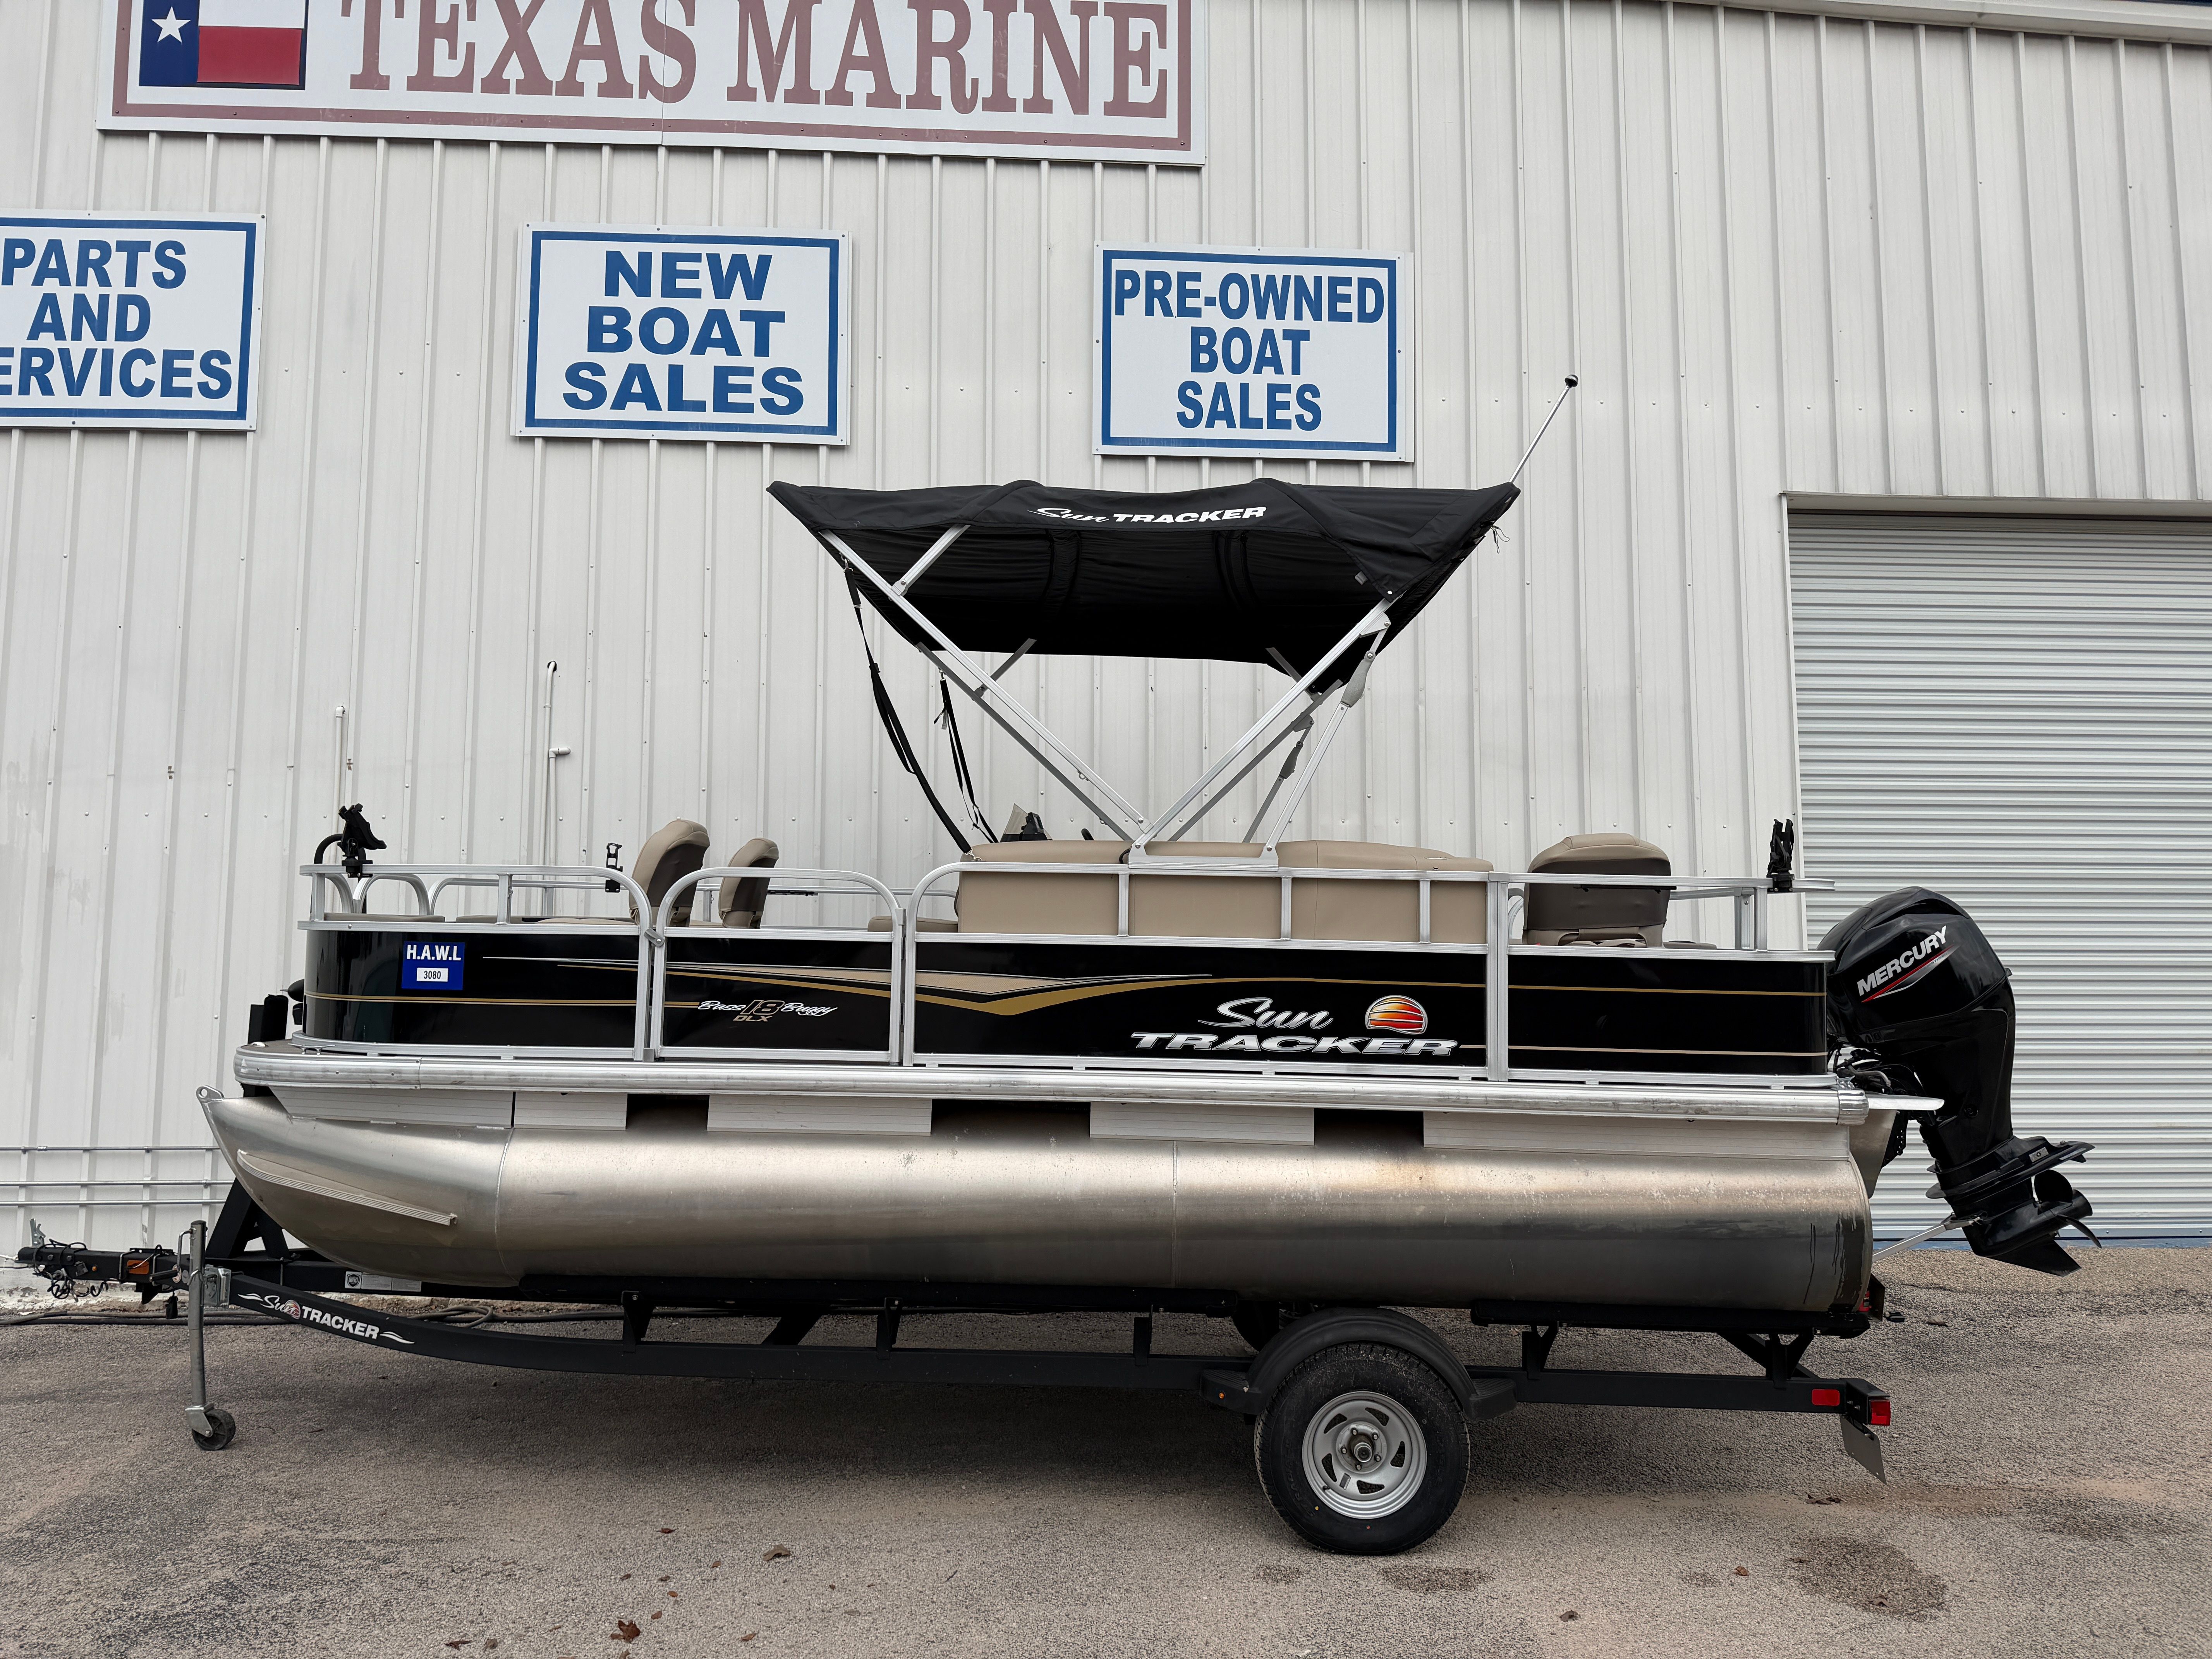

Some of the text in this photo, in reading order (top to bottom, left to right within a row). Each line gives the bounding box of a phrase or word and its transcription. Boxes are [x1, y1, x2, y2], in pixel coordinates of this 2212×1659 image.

[341, 0, 1167, 118] TEXAS MARINE
[2, 238, 186, 289] PARTS
[605, 251, 772, 301] NEW
[27, 293, 151, 342] AND
[1115, 270, 1384, 323] PRE-OWNED
[588, 307, 785, 357] BOAT
[1191, 326, 1310, 376] BOAT
[563, 362, 804, 416] SALES
[1177, 381, 1322, 431] SALES
[1027, 507, 1267, 523] Sun TRACKER
[407, 945, 461, 961] H.A.W.L
[423, 970, 441, 979] 3080
[1857, 925, 1946, 996] MERCURY
[698, 1000, 838, 1017] Bass 18 Buggy
[1197, 997, 1334, 1030] Sun
[1130, 1032, 1458, 1056] TRACKER
[260, 1295, 380, 1340] Sun TRACKER
